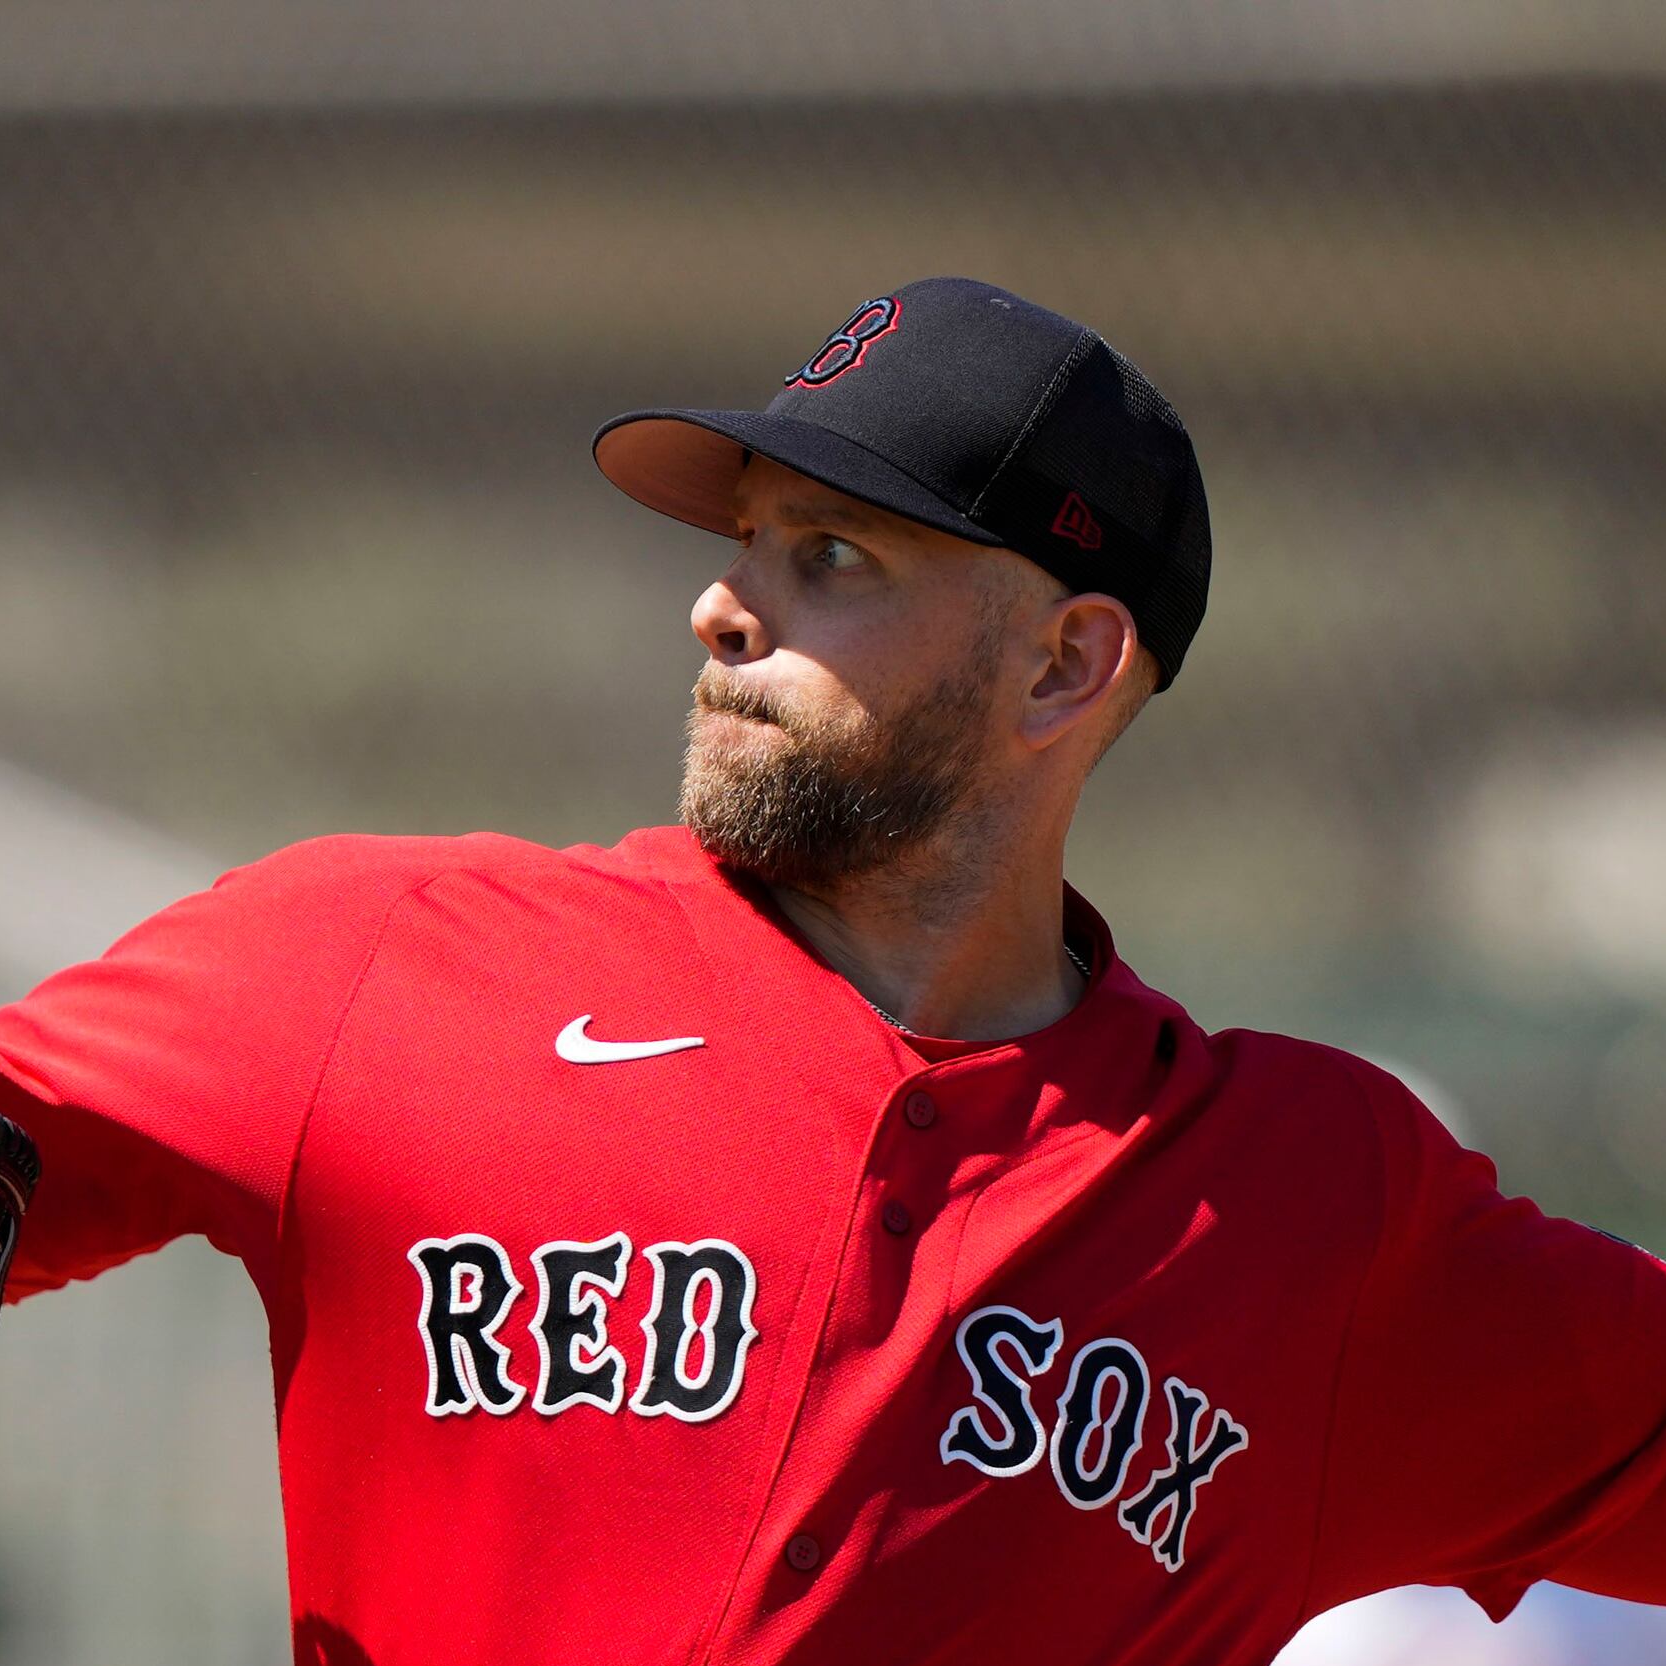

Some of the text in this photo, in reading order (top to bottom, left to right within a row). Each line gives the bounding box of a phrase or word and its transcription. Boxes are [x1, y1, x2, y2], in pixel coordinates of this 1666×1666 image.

[784, 296, 903, 390] B
[406, 1230, 1249, 1574] RED SOX
